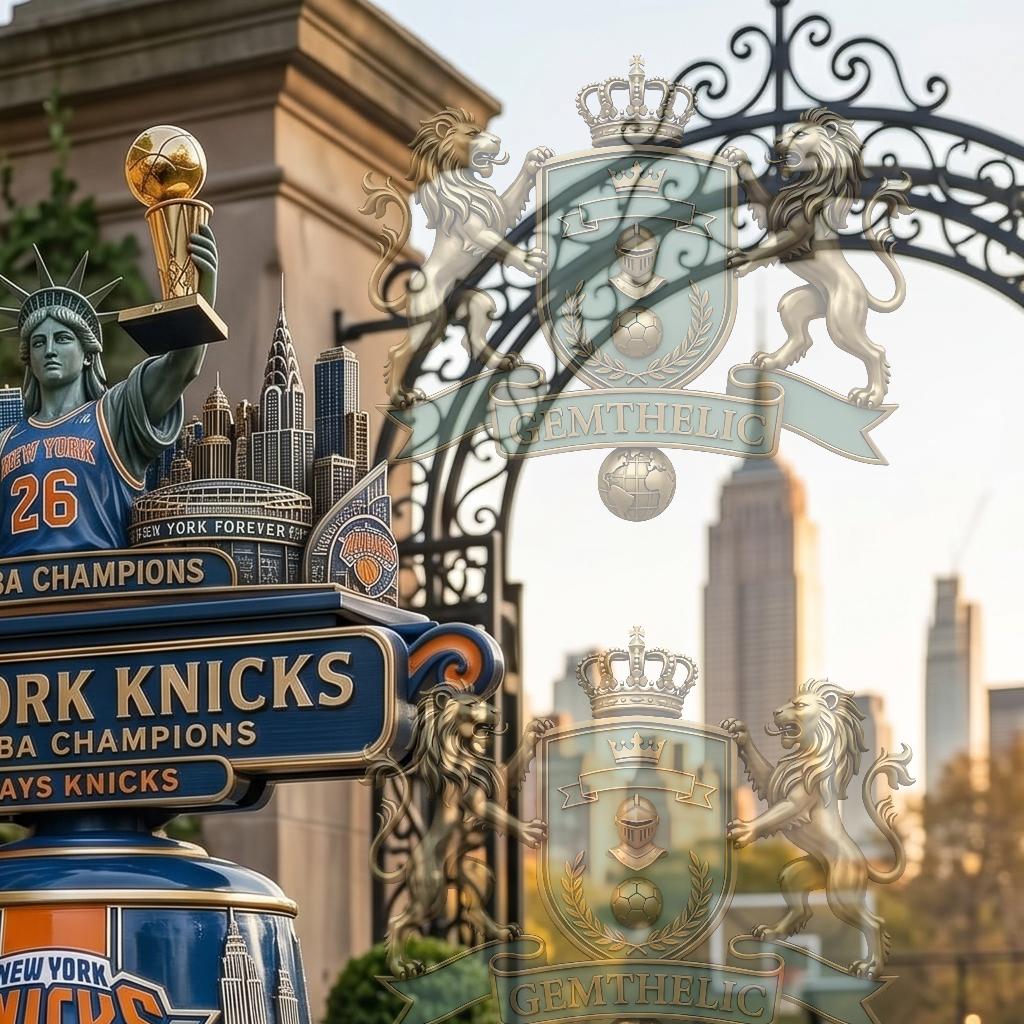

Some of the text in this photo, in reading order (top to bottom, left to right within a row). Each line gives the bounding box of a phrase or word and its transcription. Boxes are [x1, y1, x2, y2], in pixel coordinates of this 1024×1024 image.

[10, 468, 78, 534] 26
[166, 520, 207, 535] YORK
[215, 520, 286, 538] FOREVER
[32, 559, 205, 592] CHAMPIONS
[115, 651, 354, 718] KNICKS
[50, 721, 257, 755] CHAMPIONS
[64, 768, 180, 796] KNICKS
[47, 957, 111, 987] YORK
